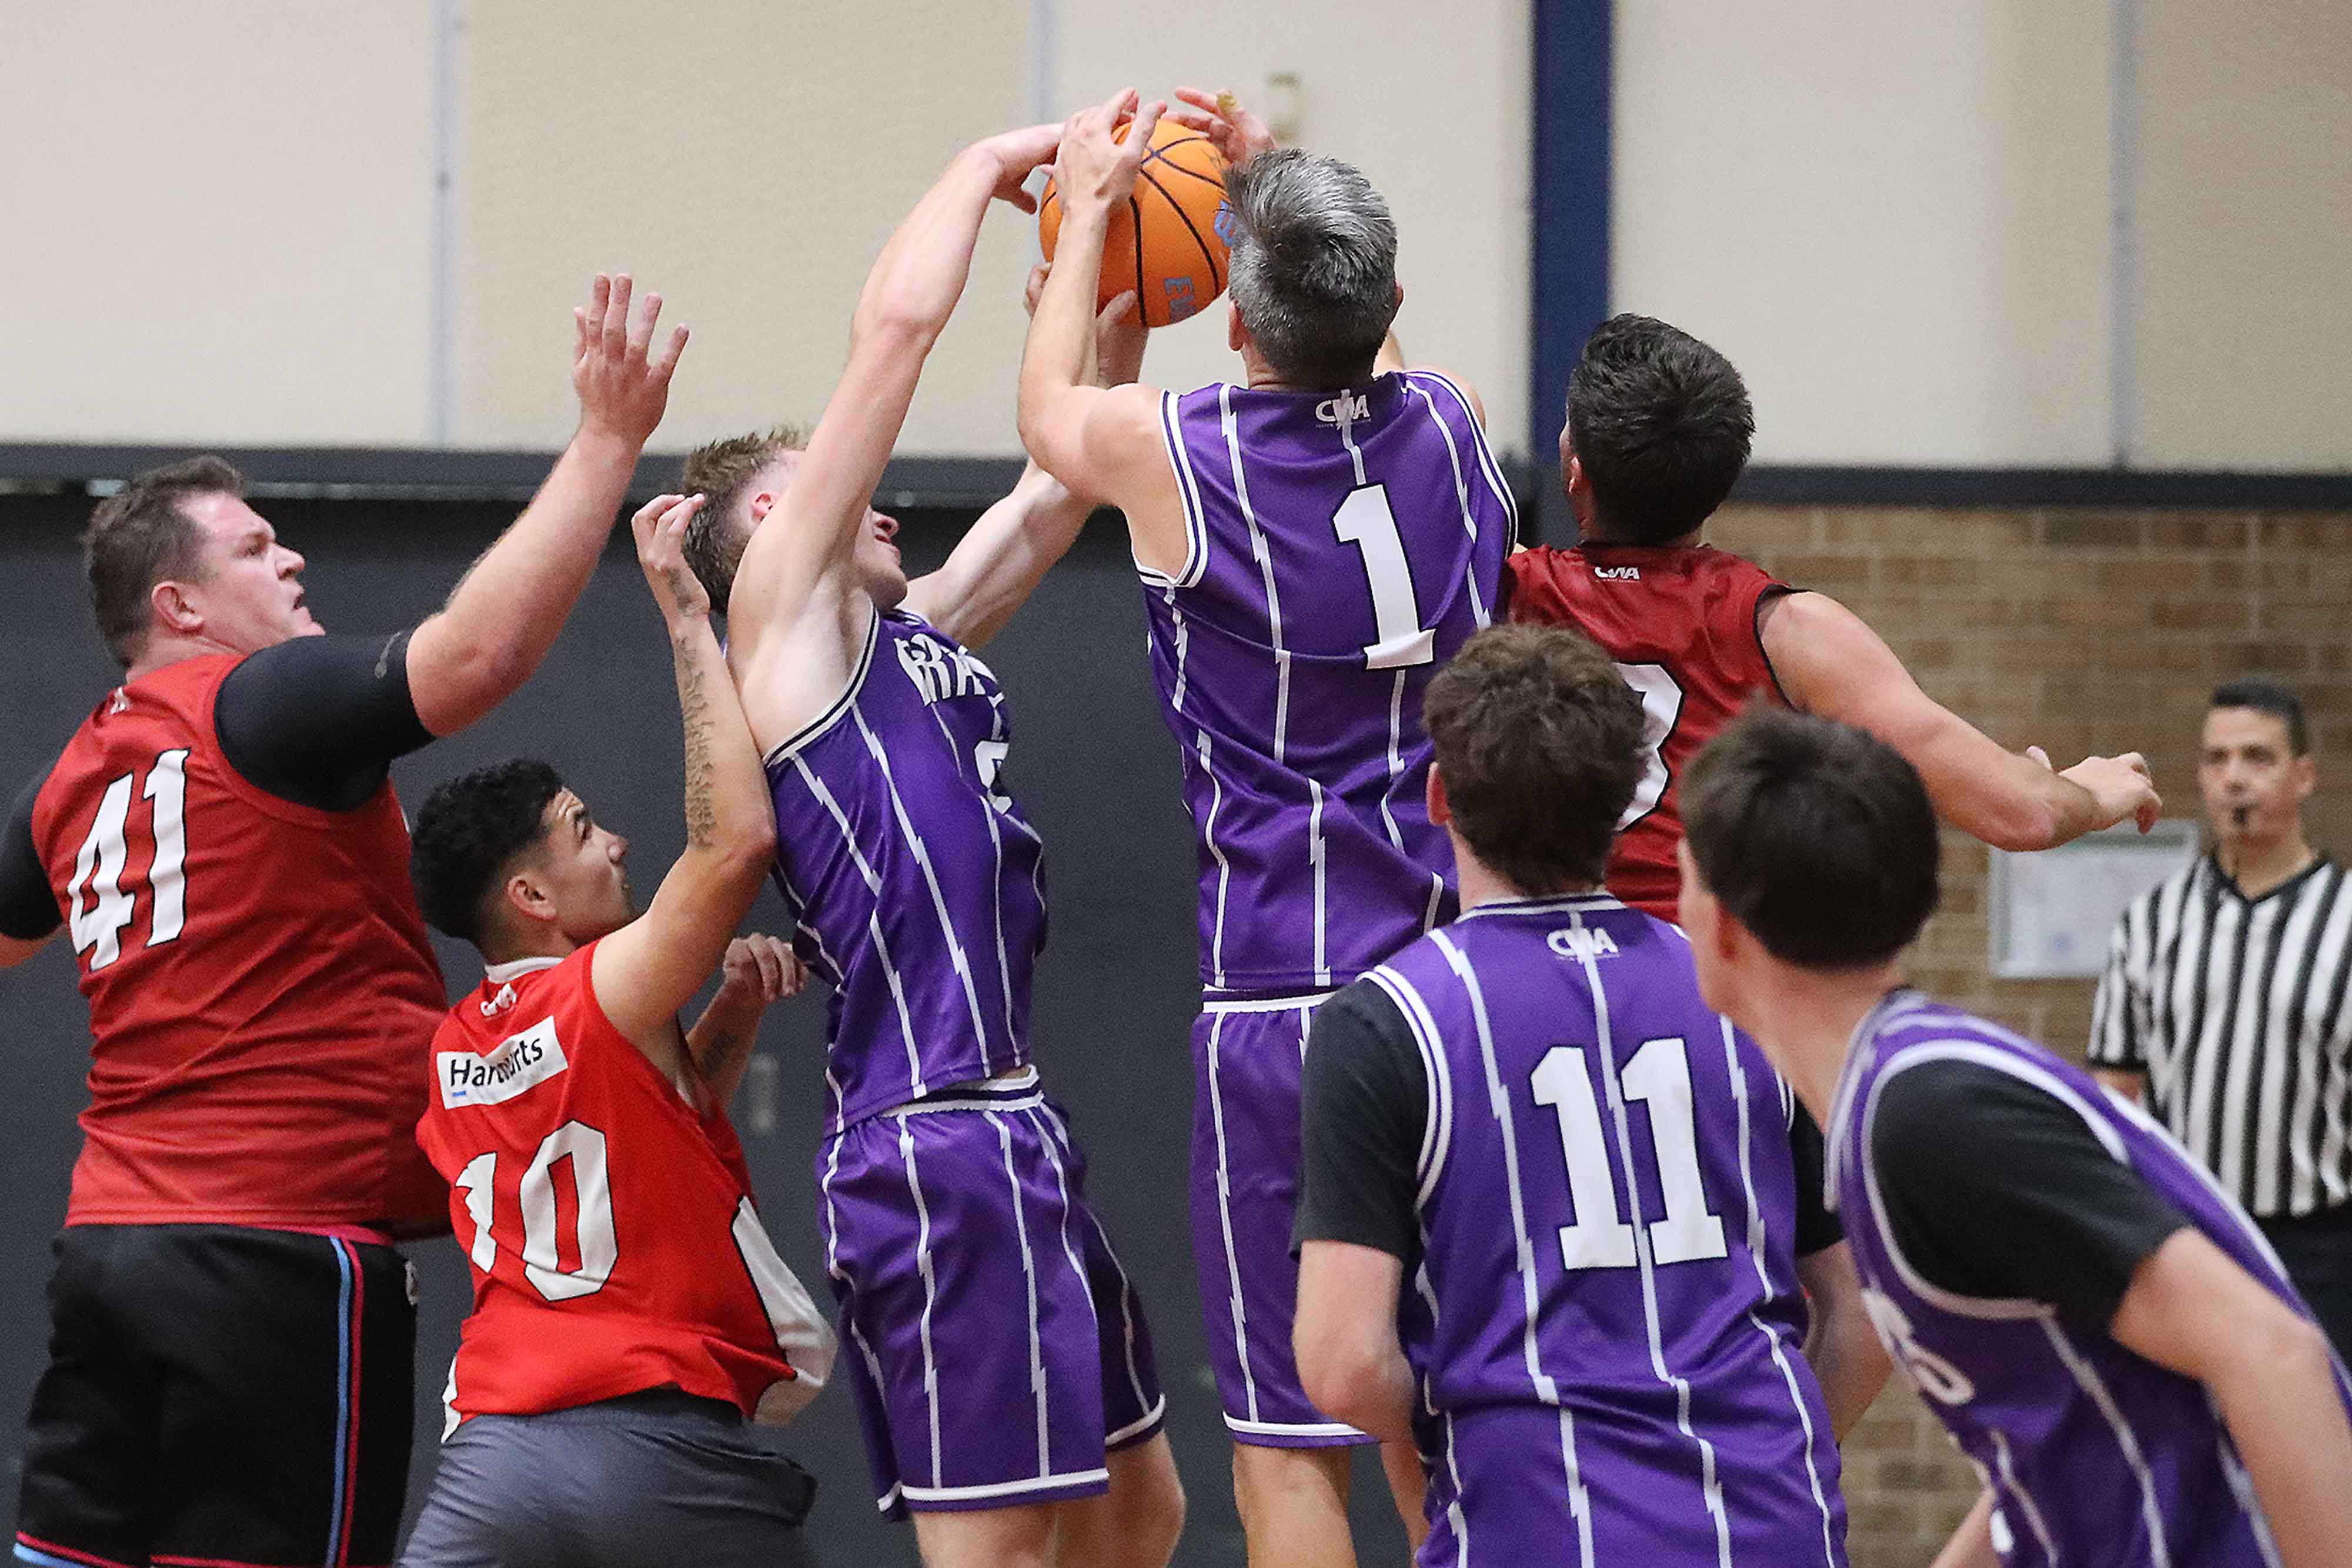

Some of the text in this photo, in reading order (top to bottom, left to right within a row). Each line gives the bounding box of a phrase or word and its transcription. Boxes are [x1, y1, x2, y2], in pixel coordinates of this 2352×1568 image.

[1332, 484, 1436, 669] 1
[67, 748, 191, 972] 41
[455, 1119, 618, 1302] 10
[1530, 1037, 1728, 1271] 11
